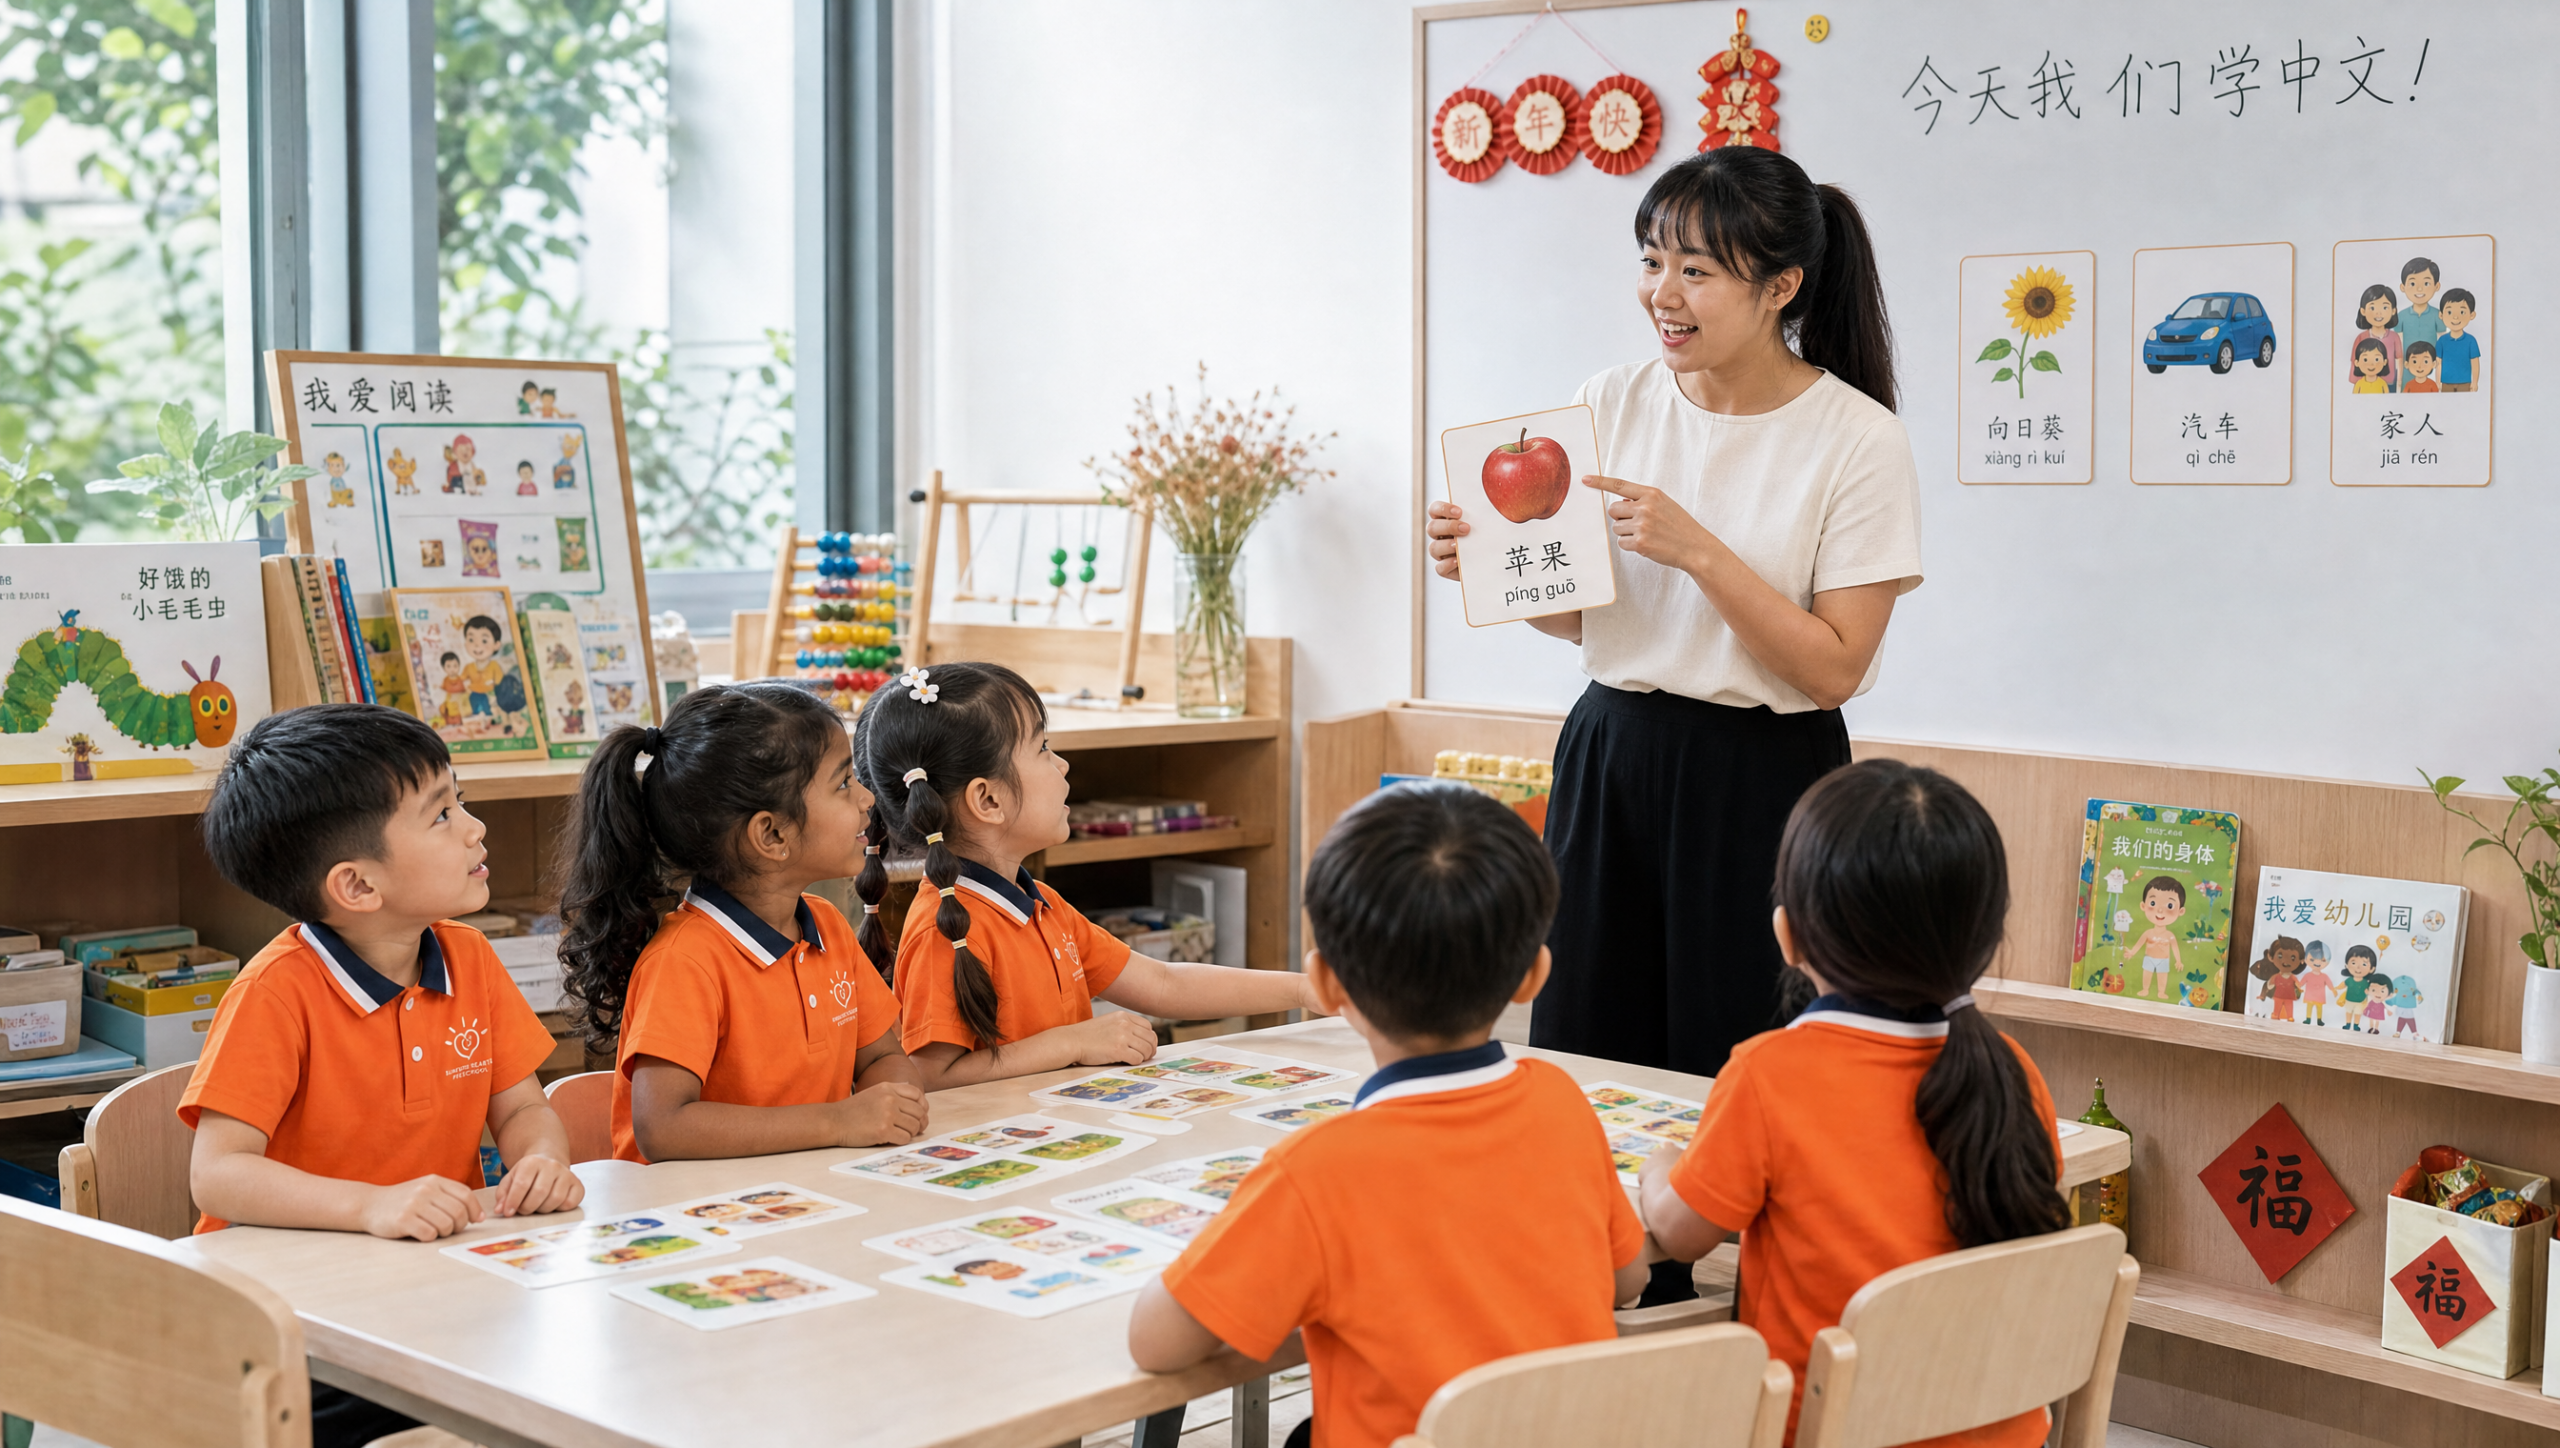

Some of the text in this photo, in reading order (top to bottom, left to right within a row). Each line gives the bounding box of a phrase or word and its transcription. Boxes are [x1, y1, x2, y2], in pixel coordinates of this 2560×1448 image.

[1902, 36, 2430, 135] 今天我们学中文！
[303, 377, 454, 414] 我爱阅读
[1988, 414, 2064, 441] 向日葵
[2182, 412, 2239, 440] 汽车
[2380, 411, 2444, 440] 家人
[1985, 450, 2065, 468] xiàng rì kuí
[2186, 449, 2200, 468] qì
[2411, 449, 2438, 464] rén
[1504, 541, 1572, 578] 苹果
[138, 567, 211, 591] 好饿的
[132, 596, 226, 622] 小毛毛虫
[1505, 586, 1540, 607] píng
[2111, 835, 2215, 866] 我们的身体
[2263, 895, 2413, 933] 我爱幼儿园
[2236, 1146, 2313, 1237] 福
[2414, 1261, 2467, 1322] 福
